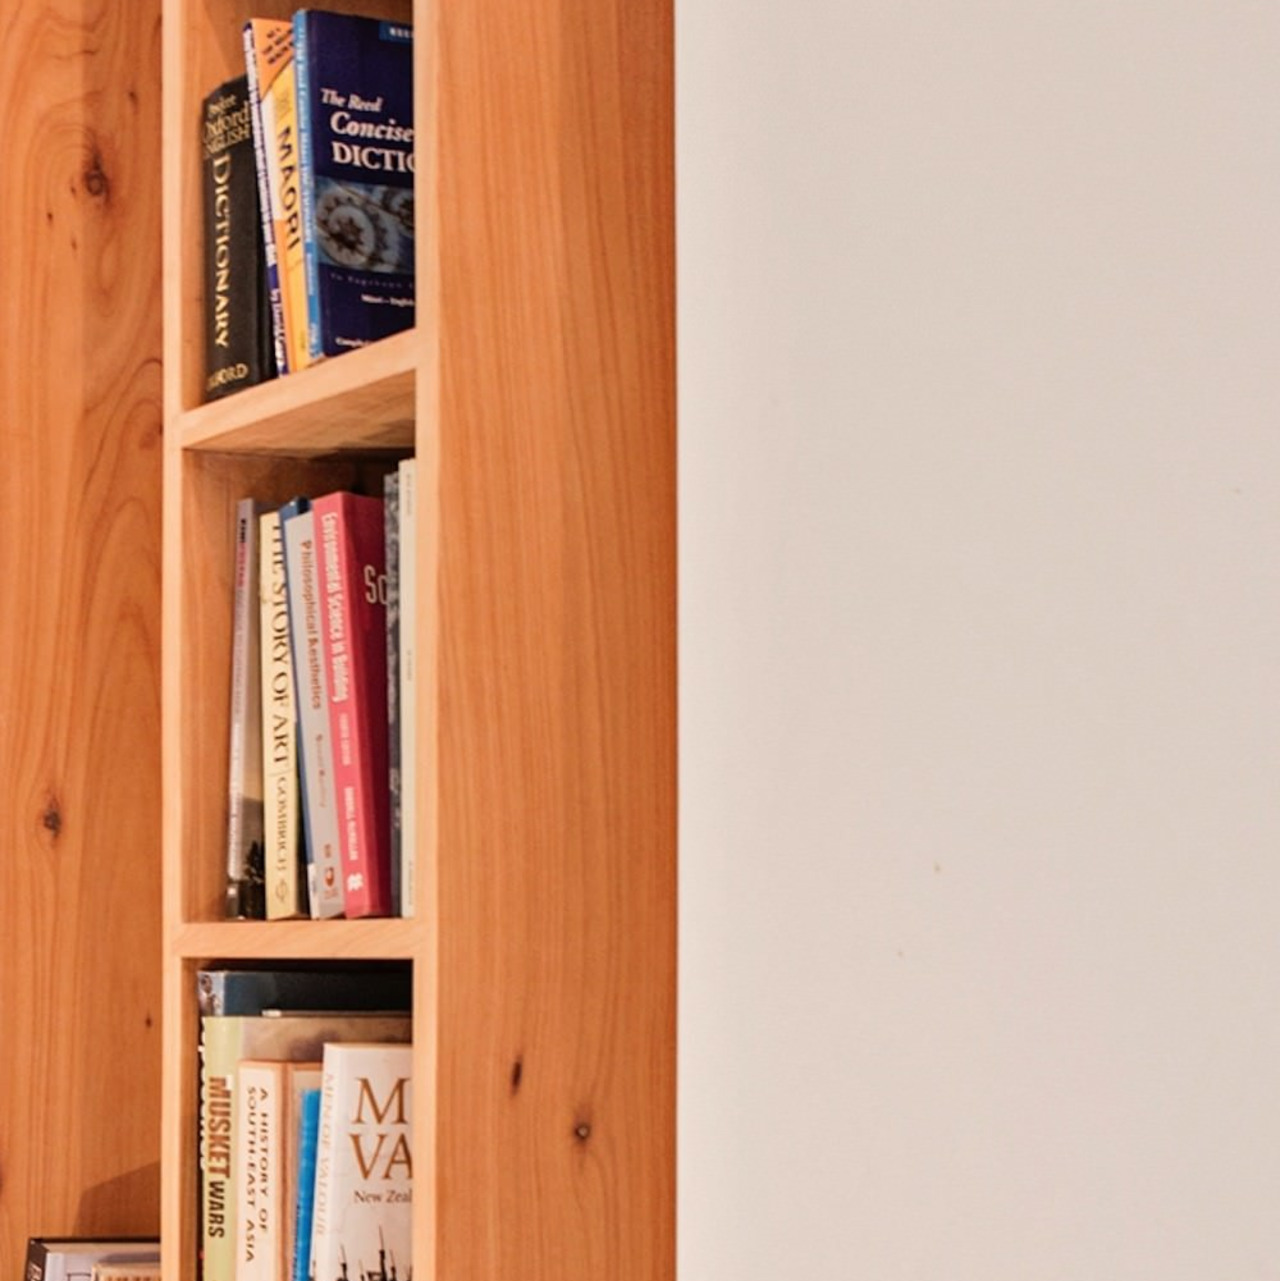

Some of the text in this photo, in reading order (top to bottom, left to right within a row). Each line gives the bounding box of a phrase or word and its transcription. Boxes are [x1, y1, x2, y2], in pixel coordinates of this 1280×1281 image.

[320, 87, 384, 113] The Reed
[330, 111, 413, 142] Concise
[279, 125, 302, 249] MAORI
[213, 154, 232, 348] DICTIONARY
[271, 581, 289, 664] STORY
[300, 540, 322, 711] Philosophical Aesthetics
[273, 671, 291, 709] OF
[273, 713, 291, 767] ART
[208, 1076, 232, 1238] MUSKET WARS
[259, 1088, 270, 1234] A HISTORY OF
[354, 1190, 383, 1204] New
[245, 1219, 255, 1262] ASIA
